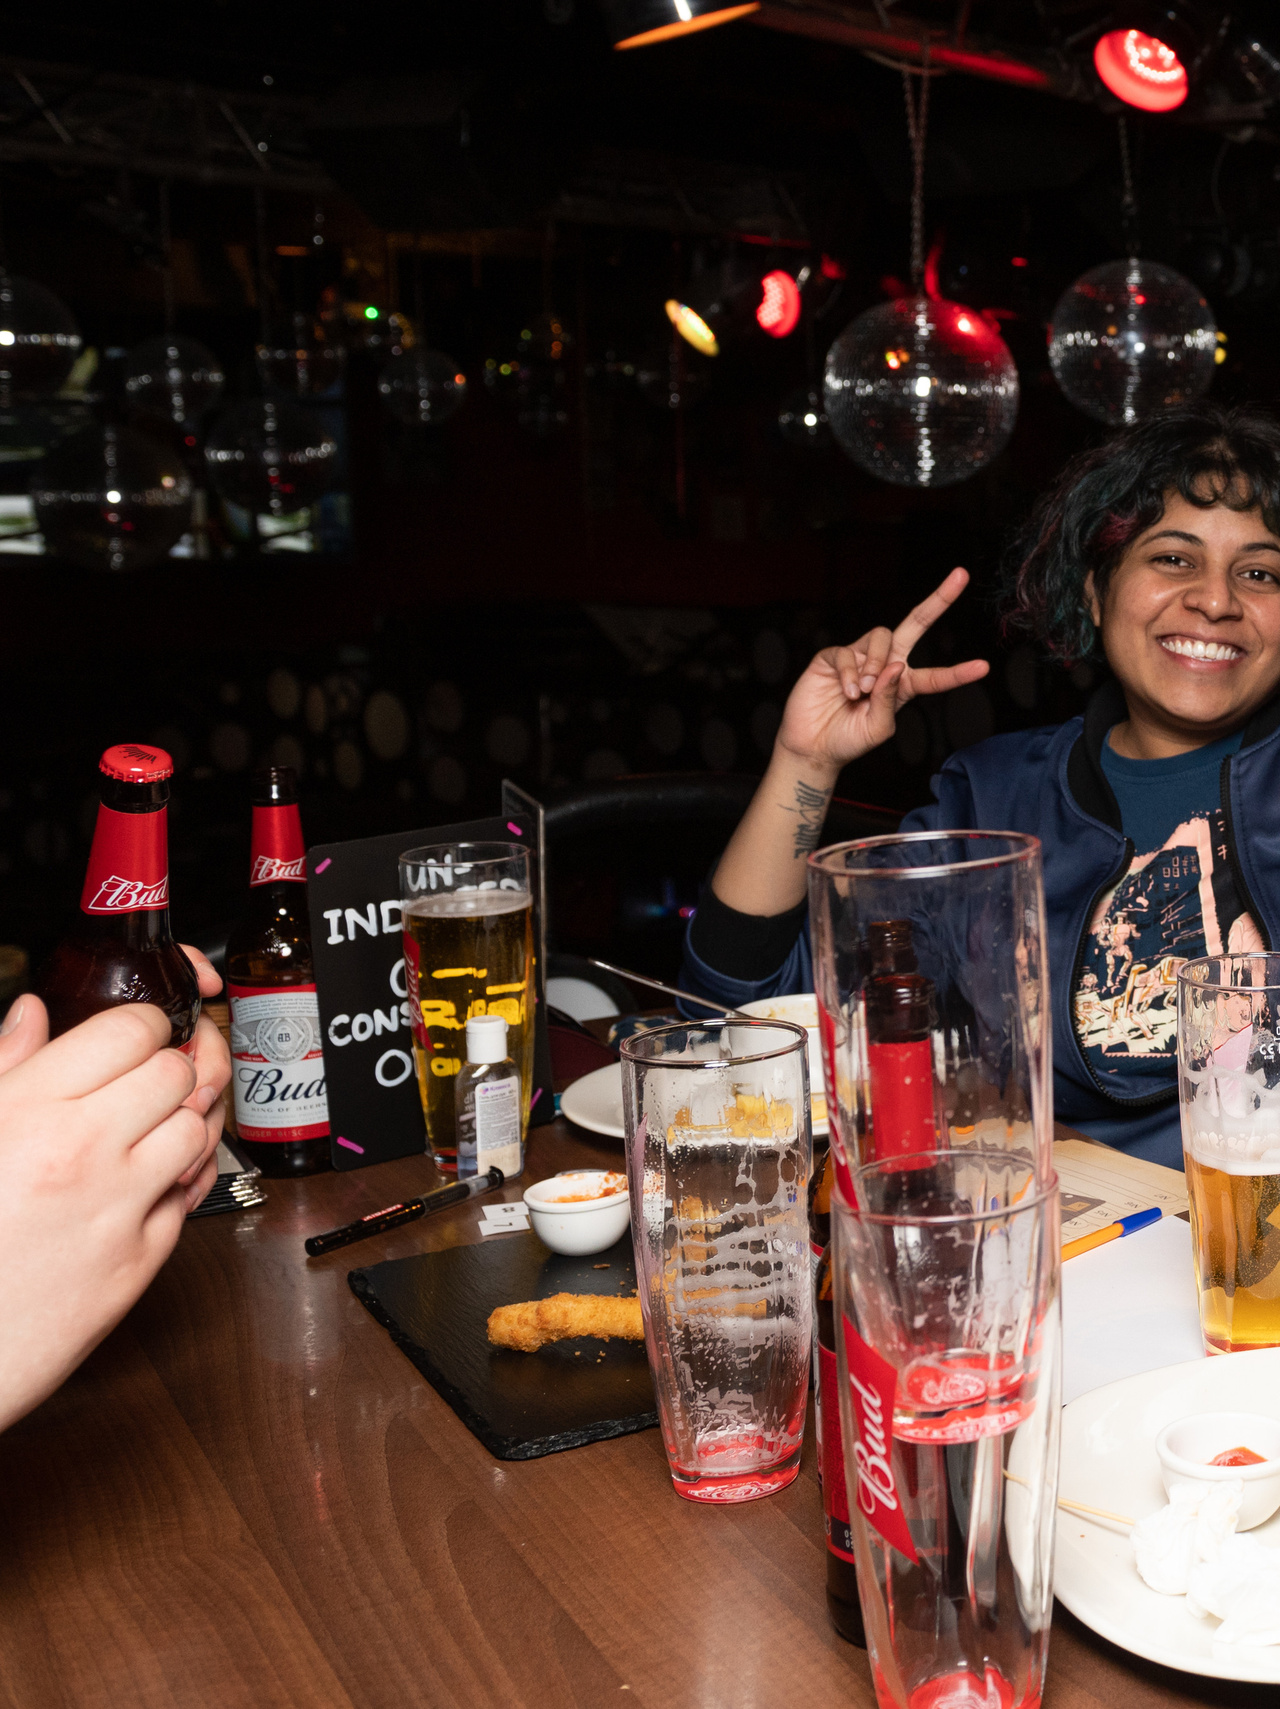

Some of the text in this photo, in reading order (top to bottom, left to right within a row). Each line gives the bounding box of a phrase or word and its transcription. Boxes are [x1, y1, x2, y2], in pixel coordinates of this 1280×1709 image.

[254, 858, 303, 880] Bud
[101, 877, 168, 908] Bud
[238, 1066, 327, 1105] Bud
[850, 1373, 898, 1515] Bud
